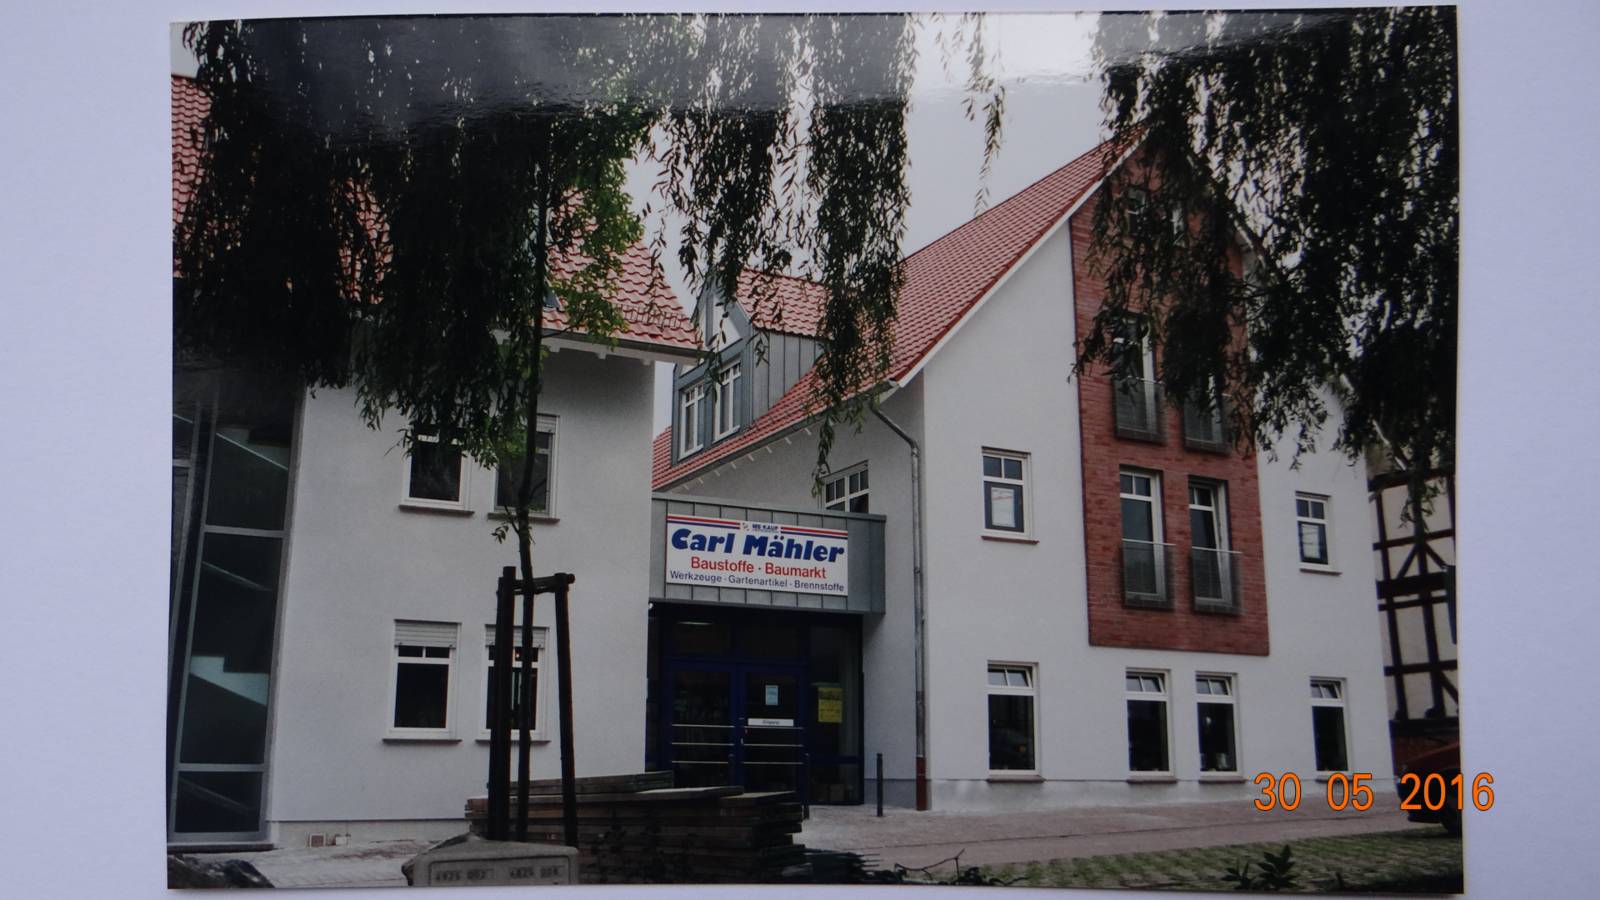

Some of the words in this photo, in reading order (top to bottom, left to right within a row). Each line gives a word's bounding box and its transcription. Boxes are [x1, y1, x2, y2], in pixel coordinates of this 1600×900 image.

[671, 528, 736, 554] Carl
[742, 534, 845, 563] Mähler
[691, 556, 754, 573] Baustoffe
[765, 562, 826, 579] Baumarkt
[670, 570, 722, 583] Werkzeuge
[728, 575, 788, 588] Gartenartikel
[794, 580, 845, 592] Brennstoffe
